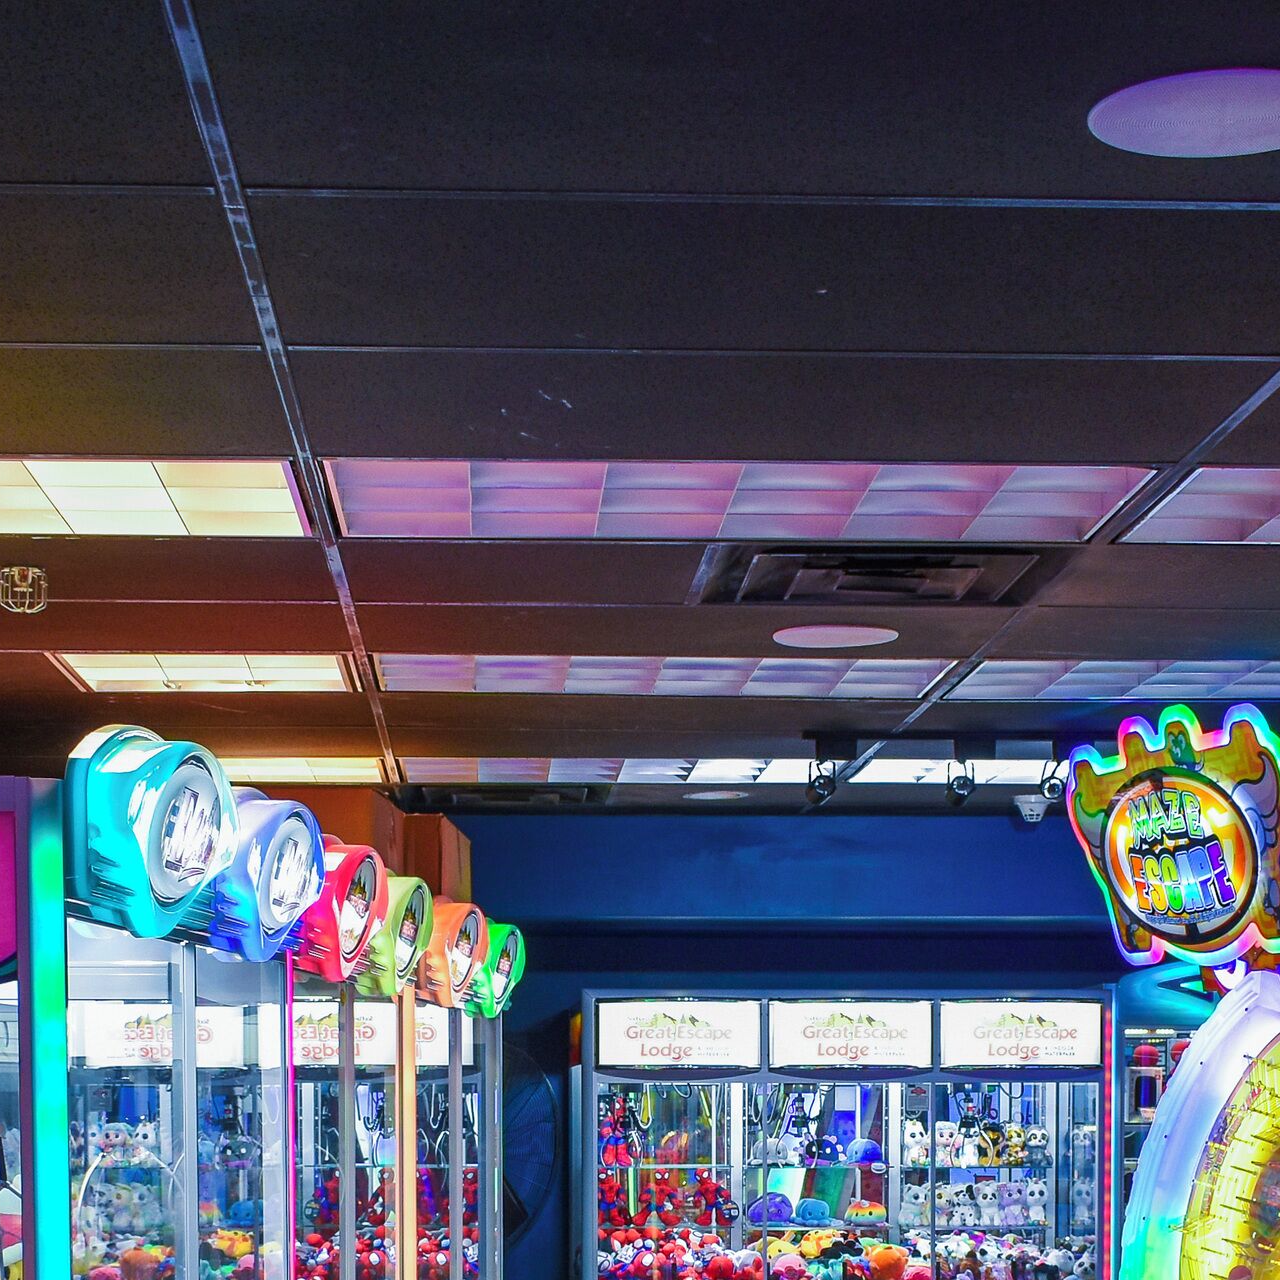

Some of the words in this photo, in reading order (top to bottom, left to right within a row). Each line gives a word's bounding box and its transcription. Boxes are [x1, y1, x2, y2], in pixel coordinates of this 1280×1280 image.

[1128, 789, 1205, 850] MAZE
[1128, 840, 1237, 914] ESCAPE
[626, 1025, 672, 1041] Great
[677, 1025, 732, 1042] Escape
[802, 1025, 850, 1041] Great
[854, 1025, 908, 1042] Escape
[974, 1025, 1021, 1041] Great
[1024, 1025, 1078, 1042] Escape
[640, 1043, 693, 1061] Lodge
[818, 1043, 869, 1061] Lodge
[988, 1043, 1040, 1061] Lodge
